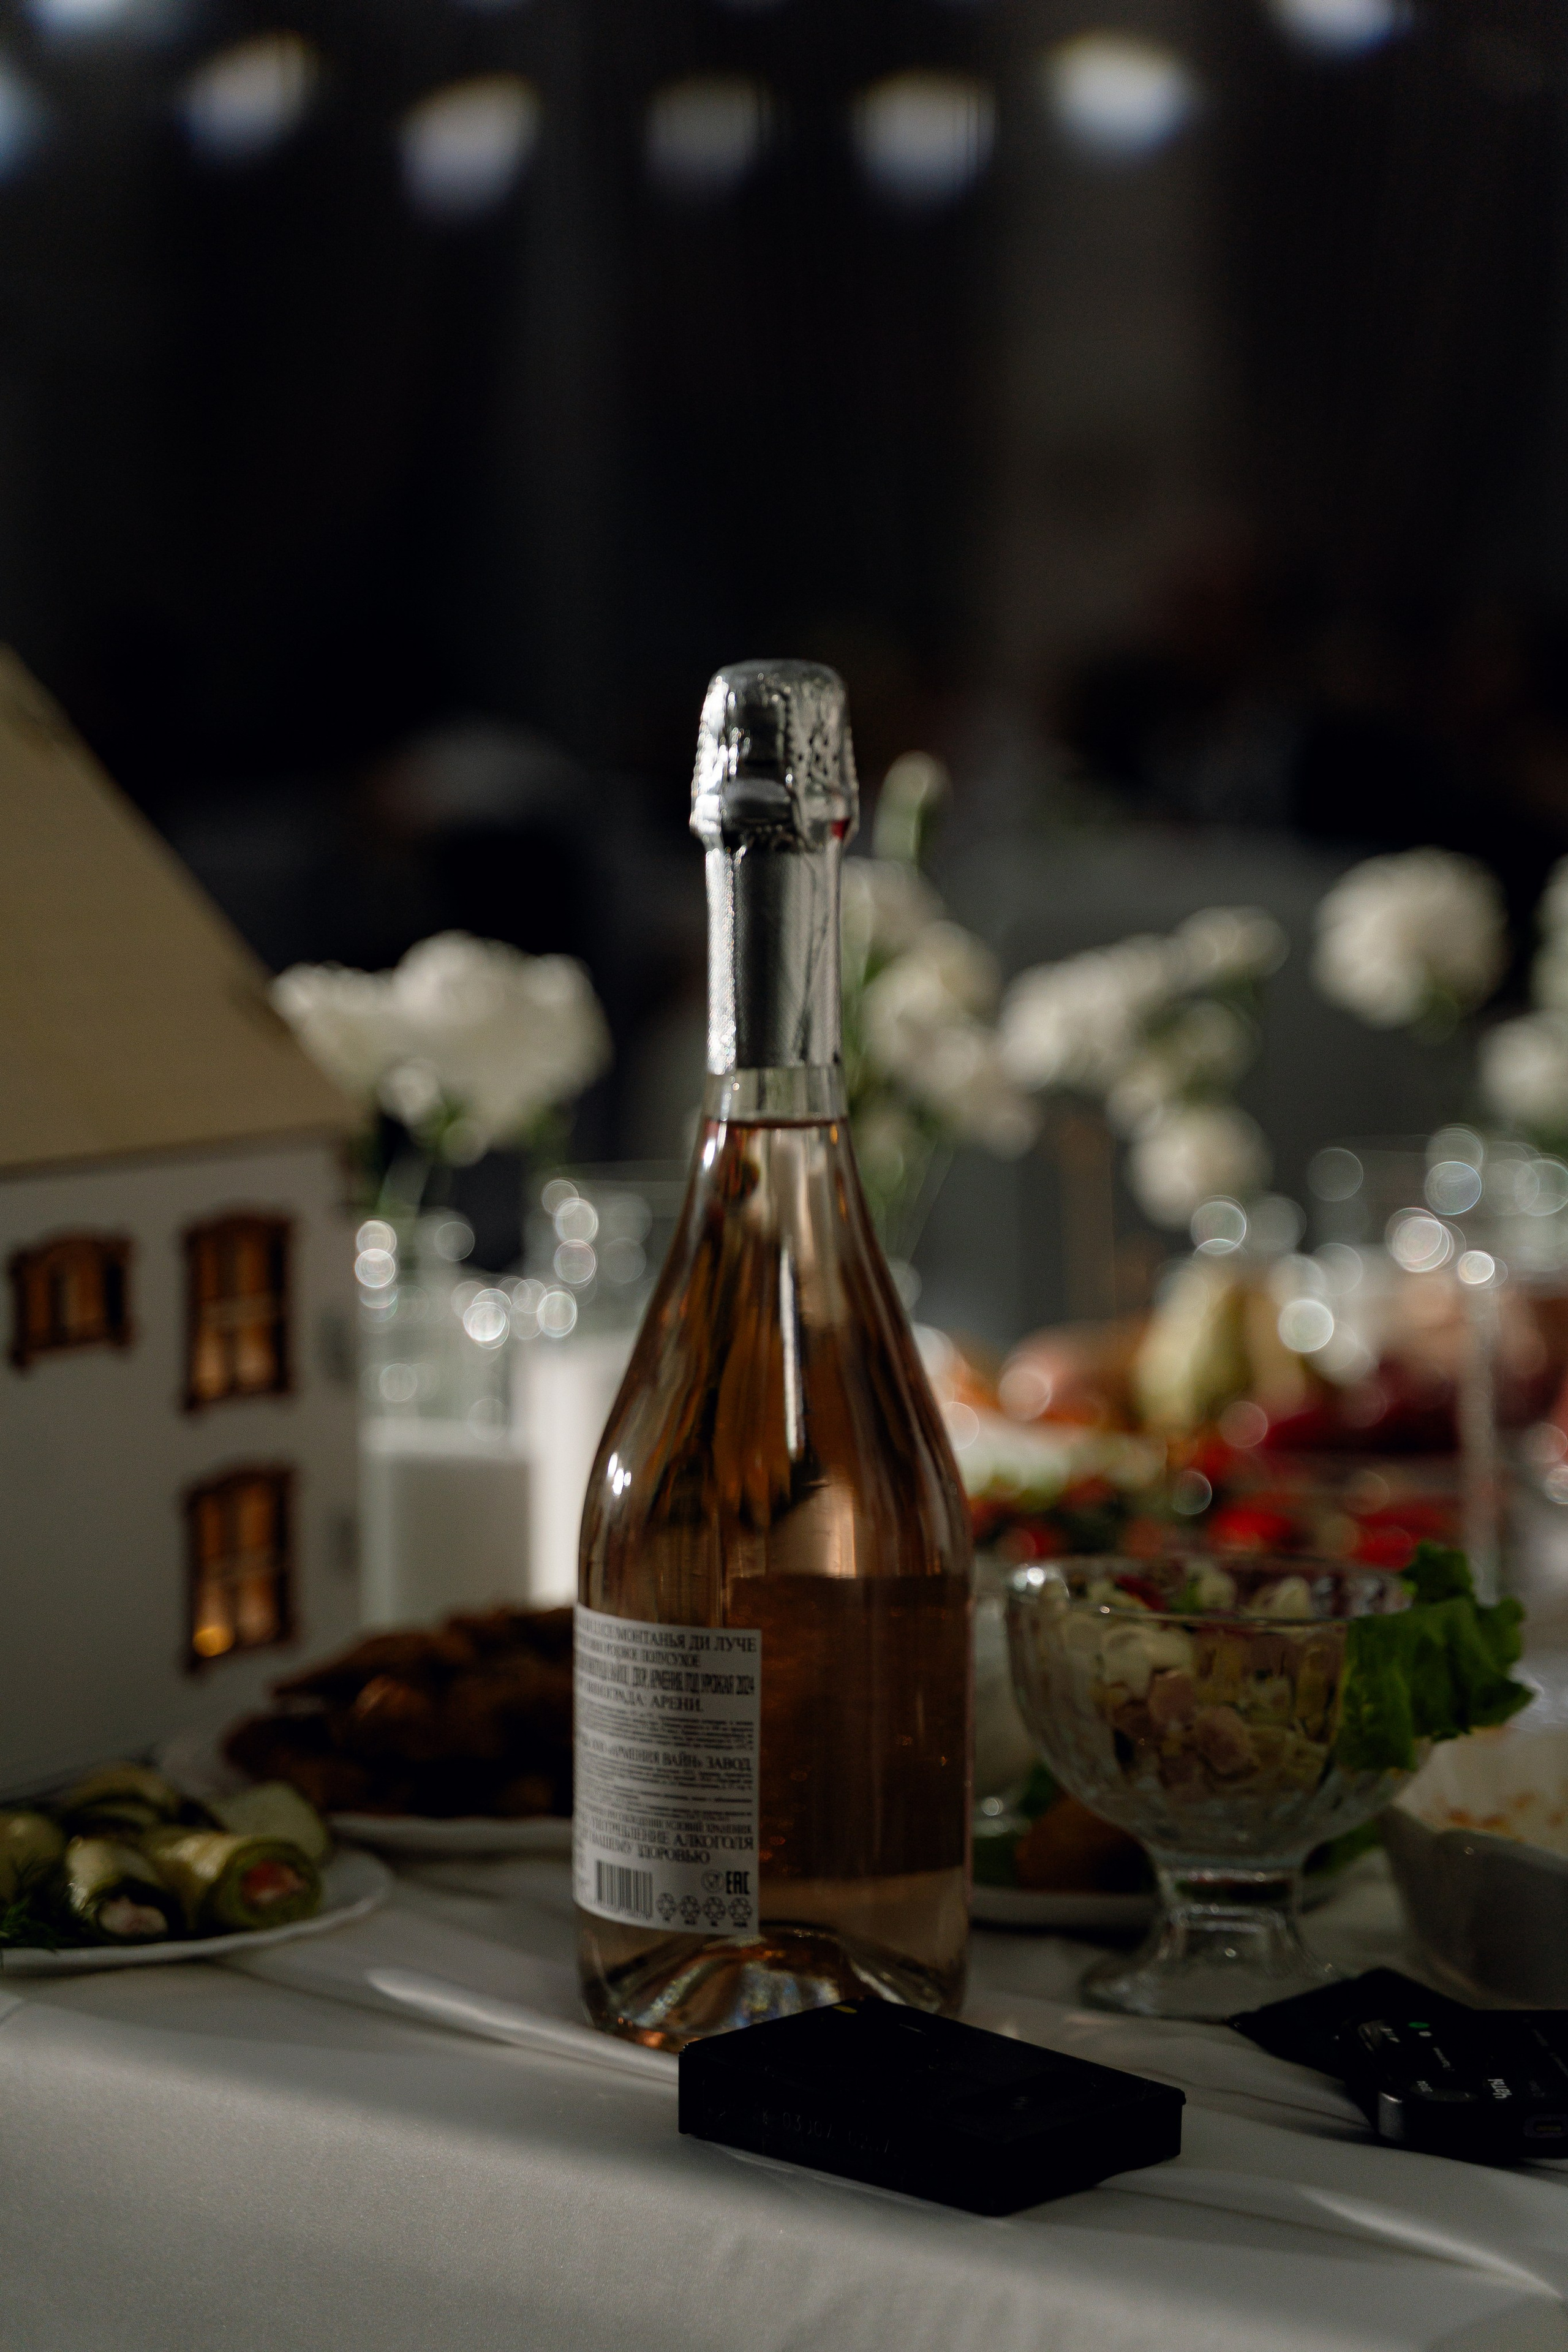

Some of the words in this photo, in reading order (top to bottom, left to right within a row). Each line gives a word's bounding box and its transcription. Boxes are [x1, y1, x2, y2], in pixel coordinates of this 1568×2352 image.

[615, 1626, 685, 1649] МОНТАНЬЯ
[688, 1635, 710, 1651] ДИ
[714, 1635, 756, 1653] ЛУЧЕ
[706, 1756, 751, 1771] ЗАВОД
[674, 1834, 754, 1850] АЛКОГОЛЯ
[636, 1843, 711, 1864] ЗДОРОВЬЮ
[1487, 2079, 1512, 2099] Чаты
